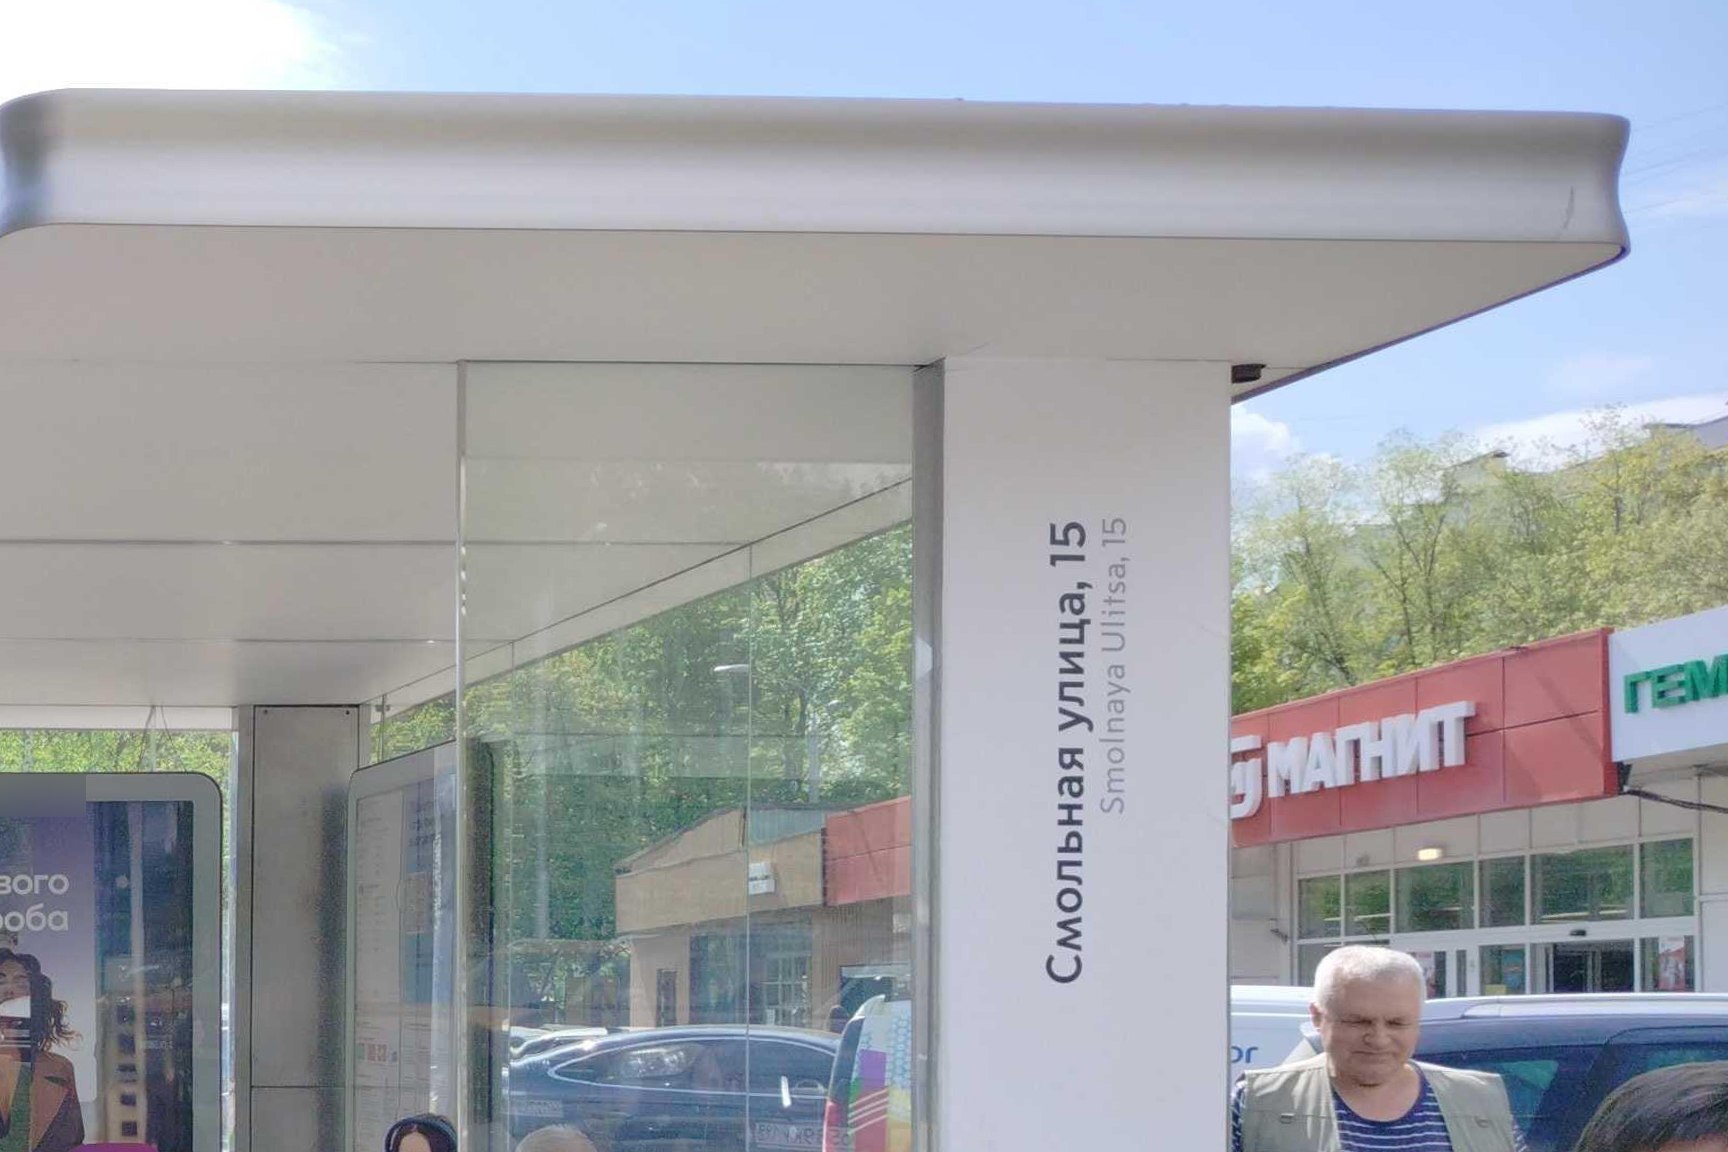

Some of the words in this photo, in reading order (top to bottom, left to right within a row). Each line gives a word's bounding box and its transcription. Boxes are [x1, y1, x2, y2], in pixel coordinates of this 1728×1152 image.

[1049, 521, 1087, 568] 15
[1101, 517, 1127, 548] 15
[1100, 556, 1131, 653] Ulitsa,
[1057, 581, 1094, 733] улица,
[1098, 663, 1132, 815] Smolnaya
[1267, 700, 1476, 799] МАГНИТ
[1045, 748, 1084, 984] Смольная
